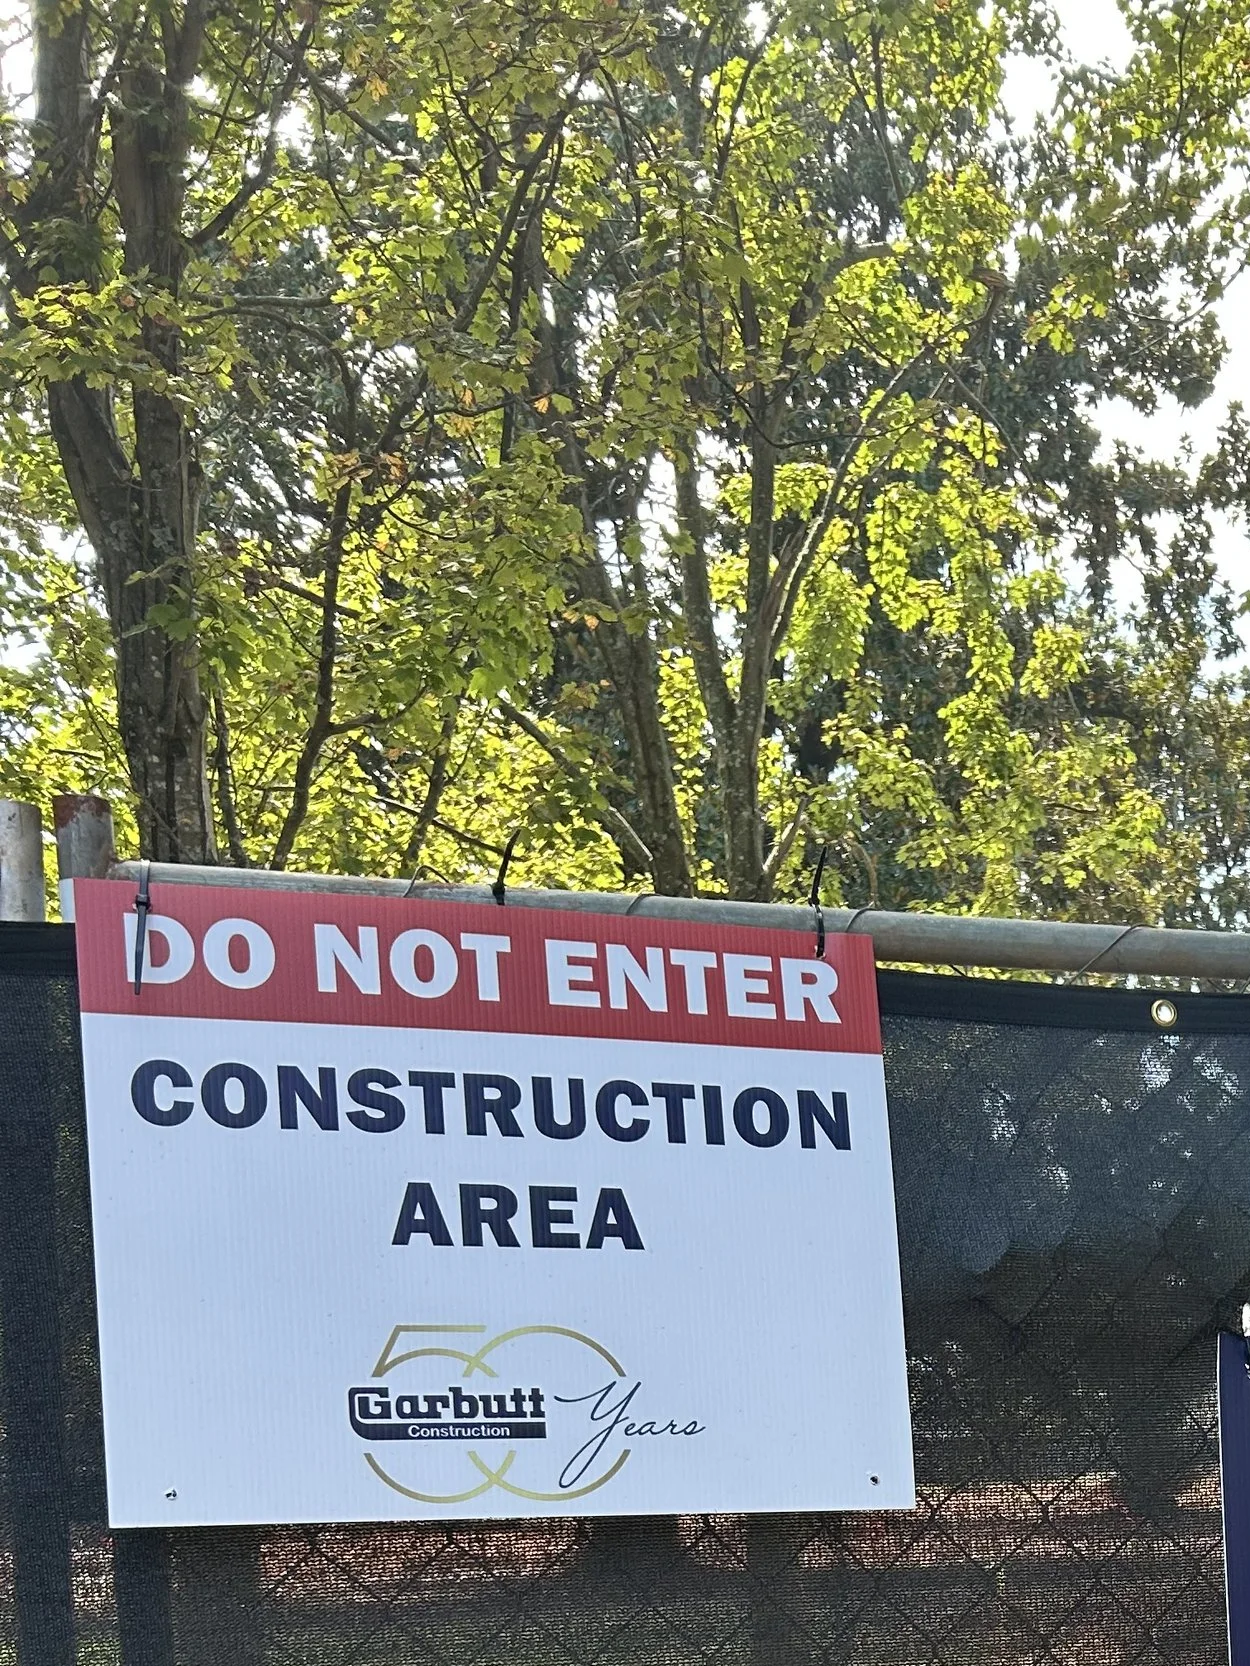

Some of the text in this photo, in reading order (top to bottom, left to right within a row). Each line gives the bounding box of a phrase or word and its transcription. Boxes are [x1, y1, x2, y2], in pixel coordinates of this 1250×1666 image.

[124, 911, 843, 1025] DO NOT ENTER
[130, 1058, 852, 1152] CONSTRUCTION
[390, 1181, 646, 1252] AREA
[358, 1381, 705, 1489] Garbutt Years
[407, 1423, 511, 1439] Construction
